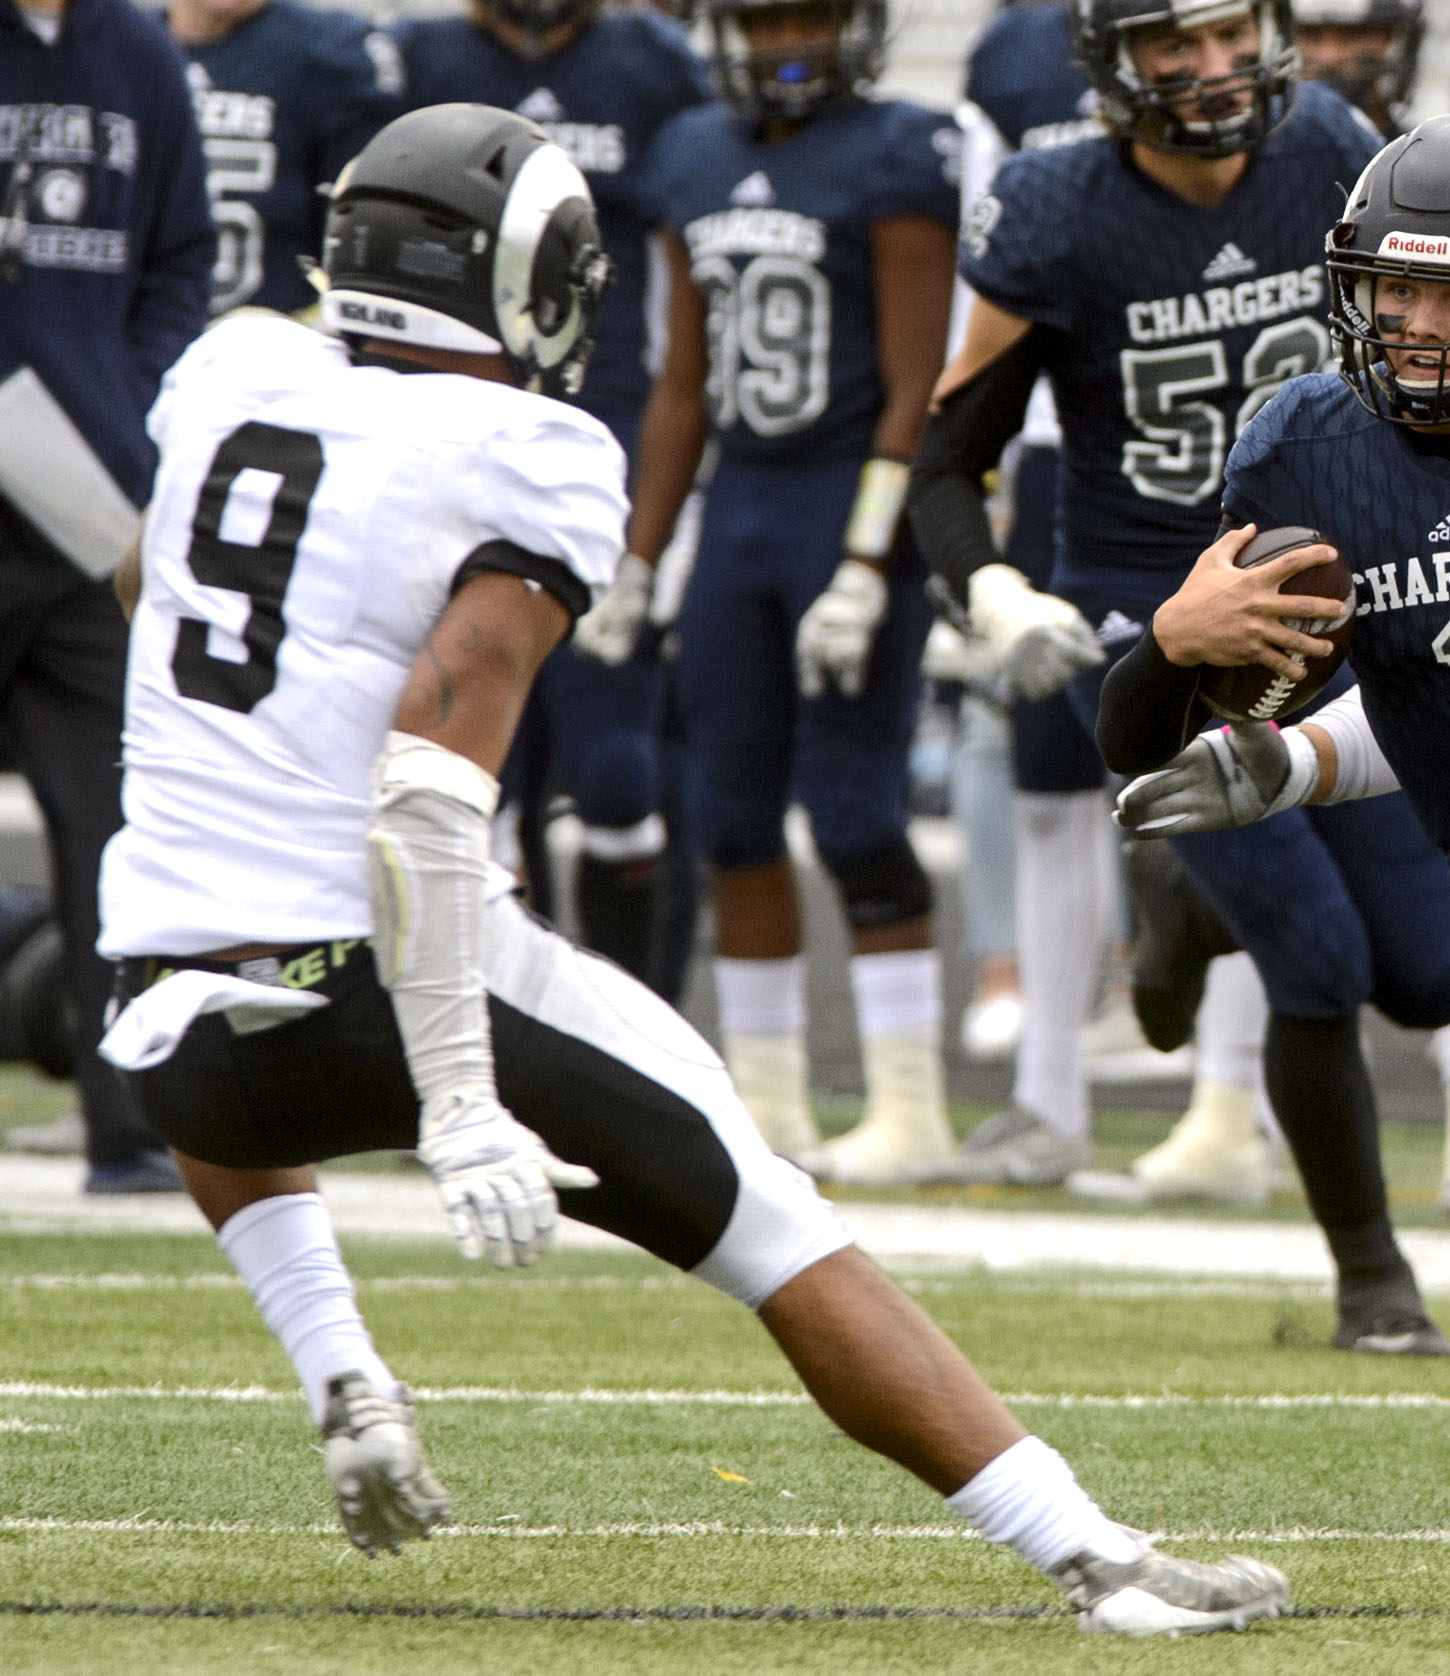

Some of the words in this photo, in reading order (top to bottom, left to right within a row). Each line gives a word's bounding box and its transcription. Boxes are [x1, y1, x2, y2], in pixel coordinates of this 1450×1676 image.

[1388, 236, 1448, 255] Riddell
[1127, 264, 1324, 343] CHARGERS
[171, 420, 326, 714] 9
